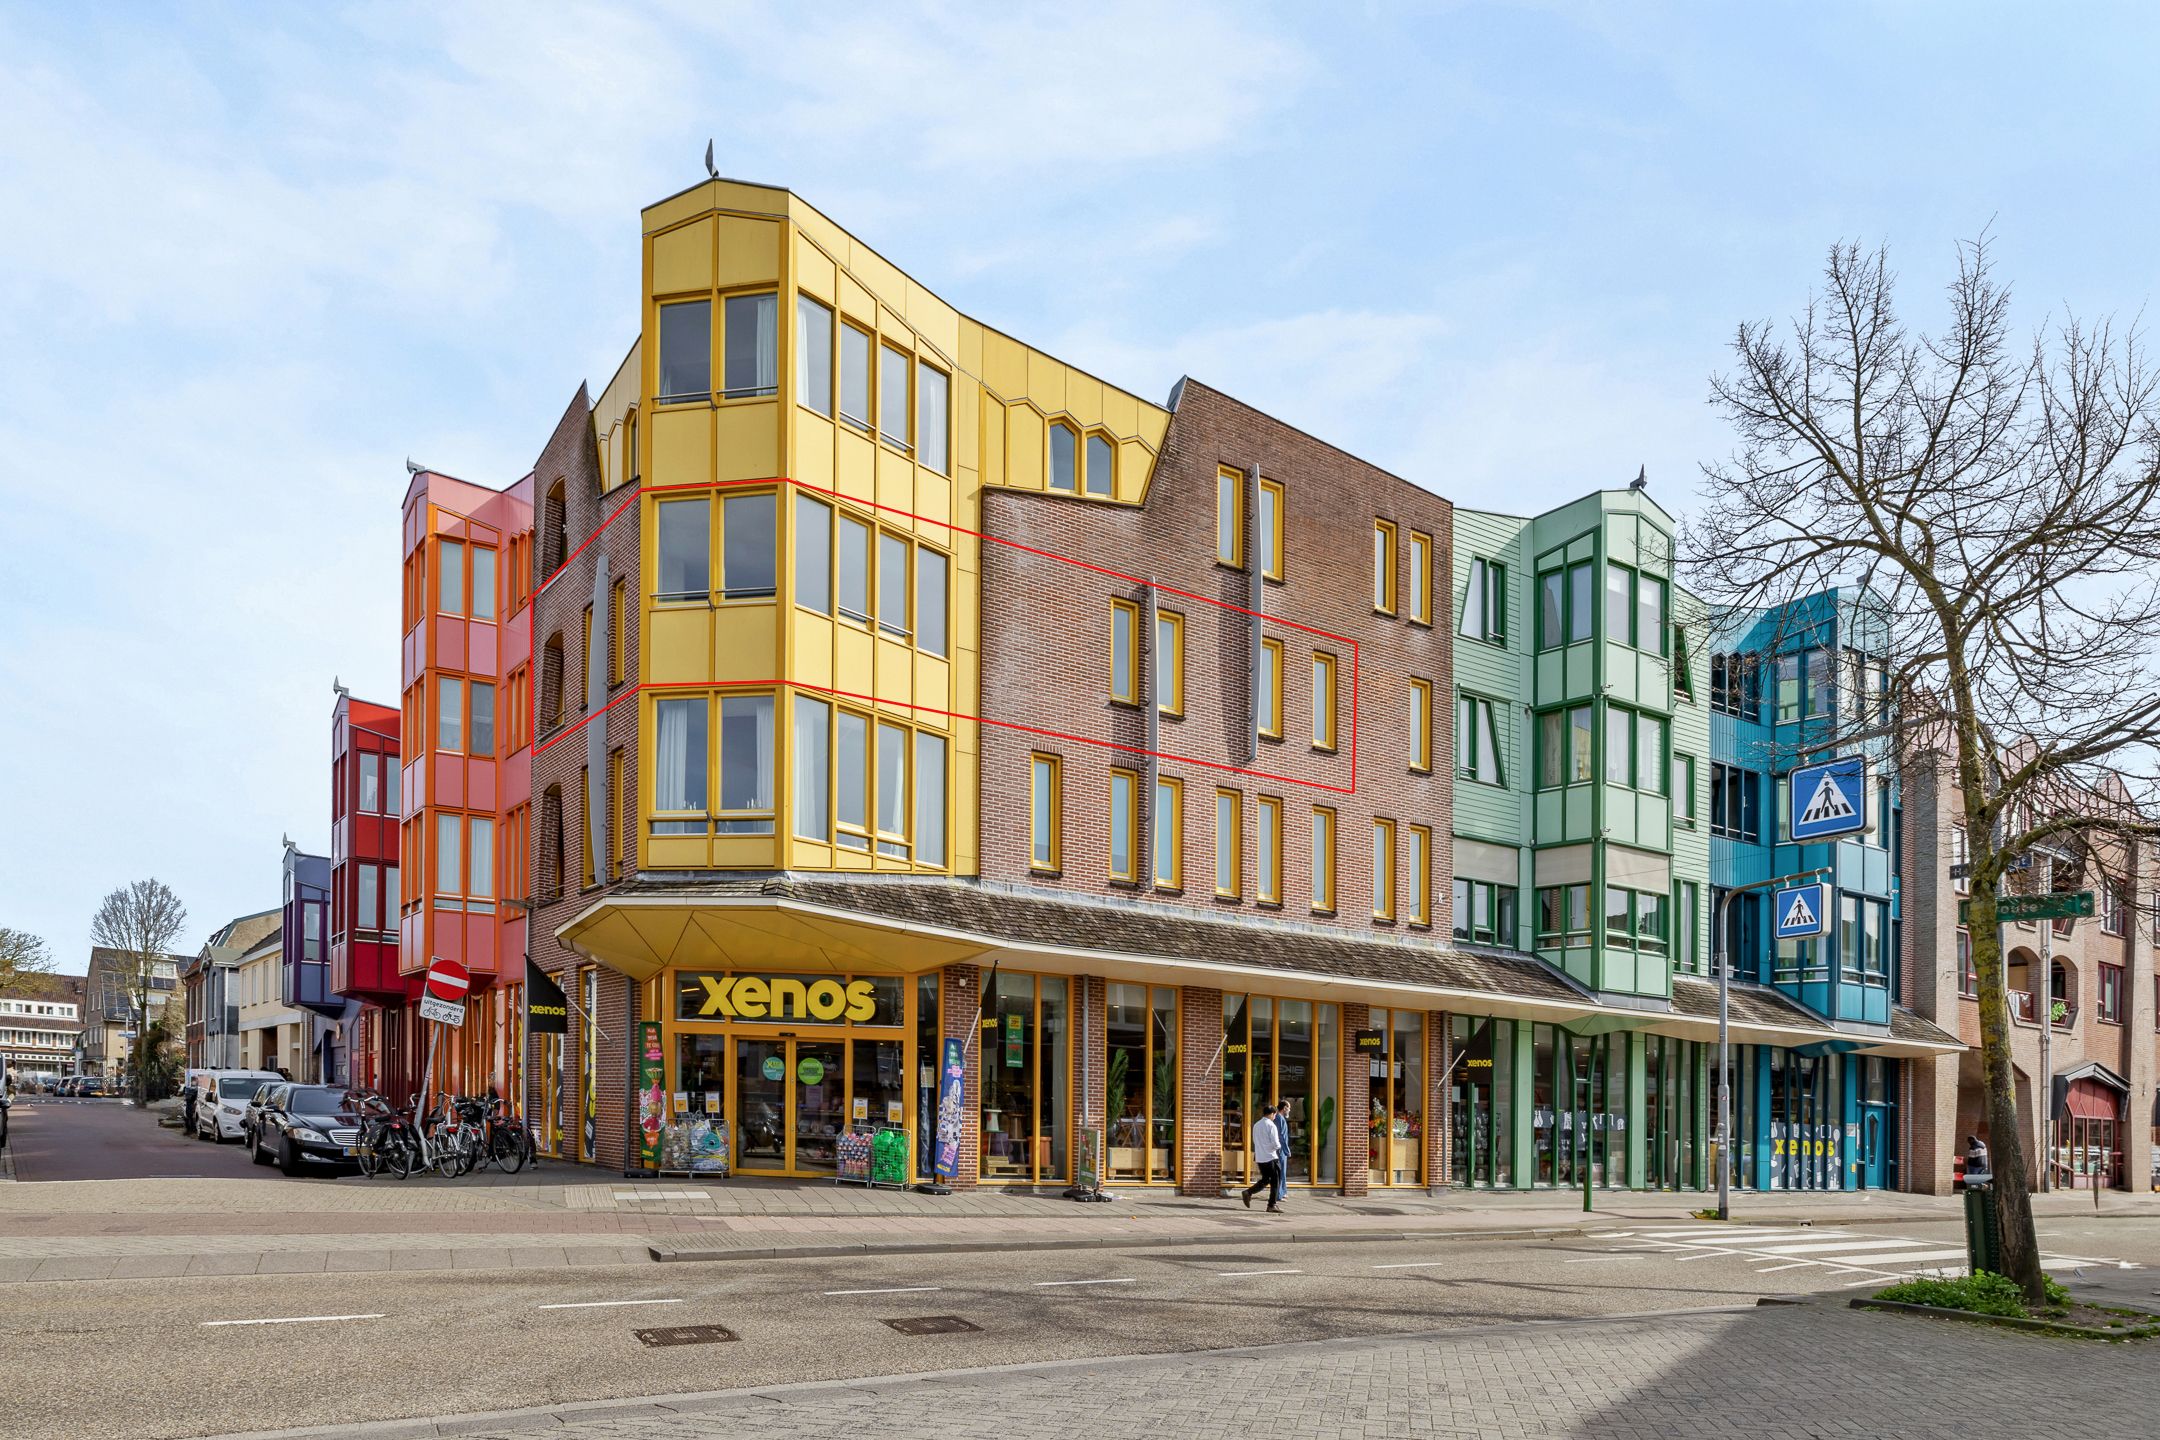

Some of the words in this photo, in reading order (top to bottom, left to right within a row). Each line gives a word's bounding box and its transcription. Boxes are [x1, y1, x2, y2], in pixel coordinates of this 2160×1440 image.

[698, 976, 876, 1022] xenos
[424, 1000, 464, 1013] uitgezonderd
[529, 1004, 566, 1016] xenos
[1360, 1038, 1380, 1046] xenos
[1227, 1044, 1247, 1054] xenos
[1467, 1059, 1493, 1067] xenos
[1775, 1139, 1835, 1156] xenos
